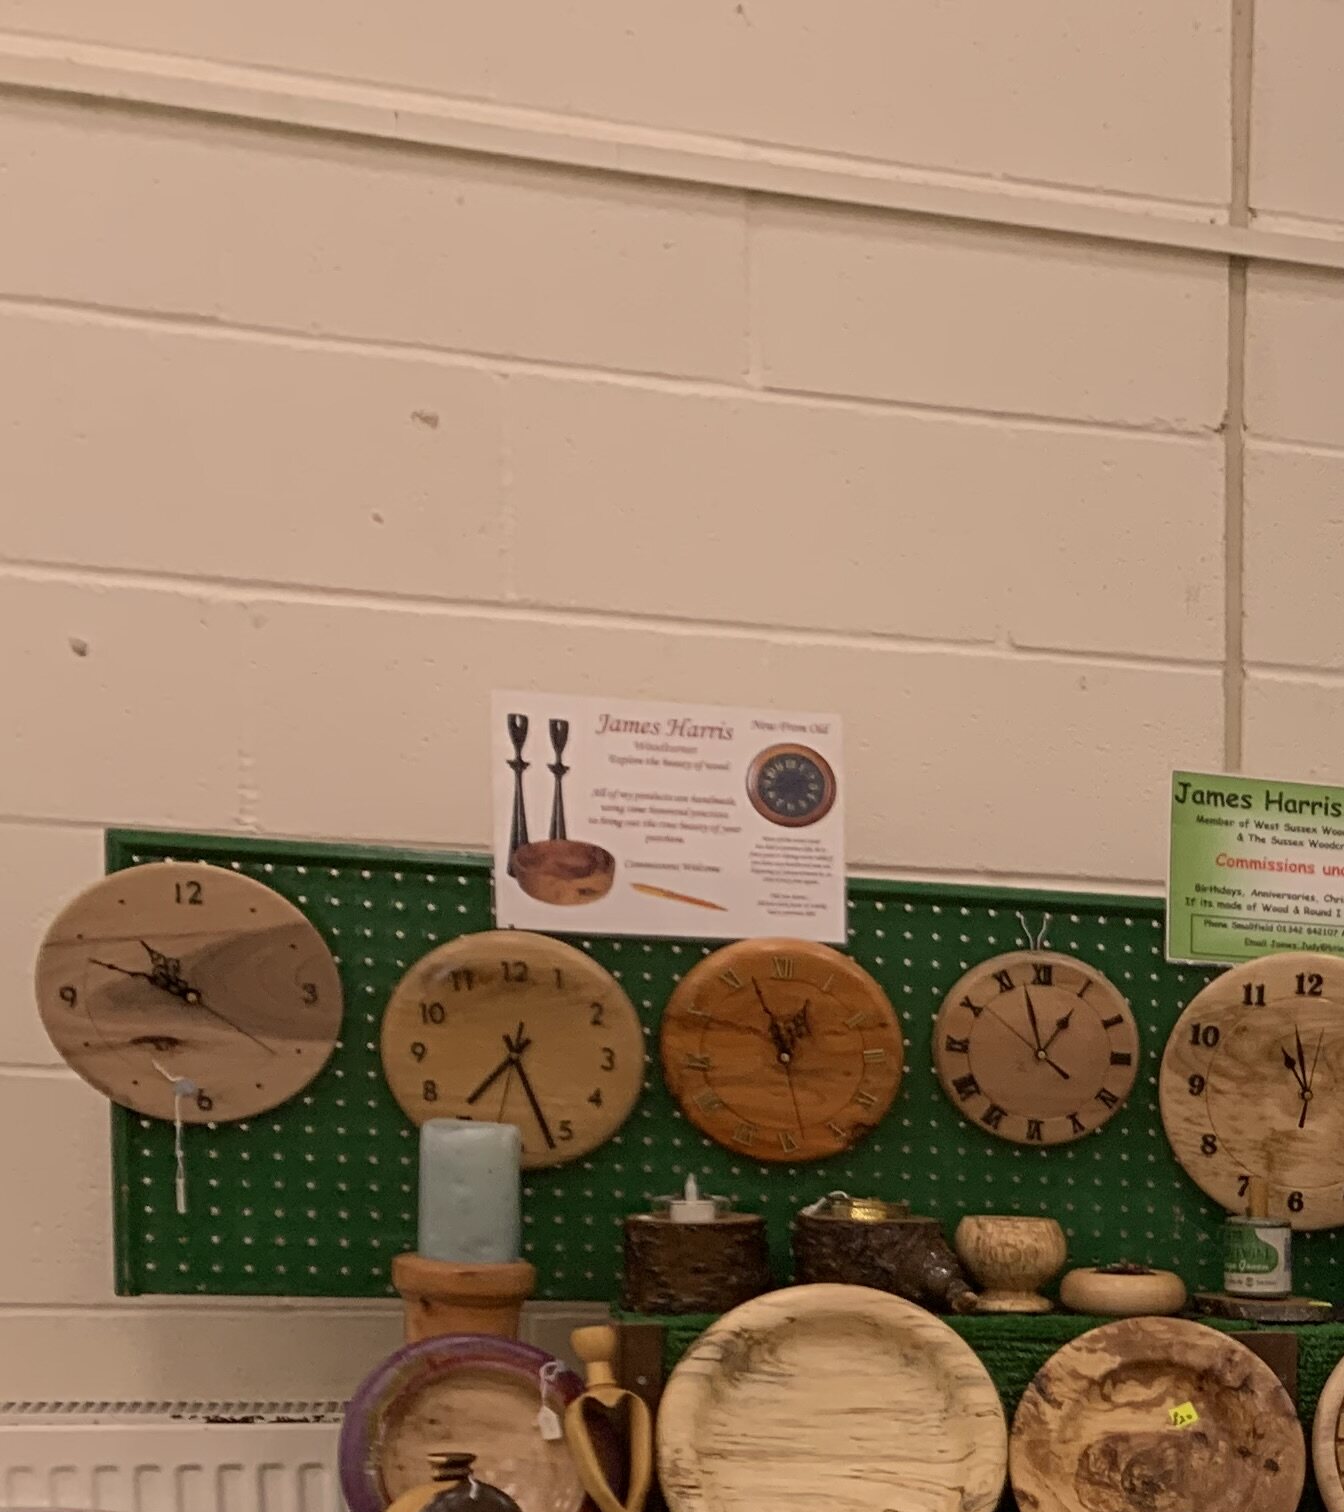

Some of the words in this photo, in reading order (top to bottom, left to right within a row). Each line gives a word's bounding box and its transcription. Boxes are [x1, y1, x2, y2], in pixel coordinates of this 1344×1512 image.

[595, 713, 661, 735] James
[665, 718, 734, 740] Harris
[1175, 782, 1253, 809] James
[1265, 790, 1342, 817] Harris
[1196, 815, 1235, 827] Member
[1239, 819, 1249, 828] of
[1254, 820, 1279, 831] West
[1284, 823, 1317, 834] Sussex
[1237, 833, 1244, 842] &
[1248, 833, 1266, 844] The
[1271, 836, 1304, 847] Sussex
[1215, 852, 1315, 874] Commissions
[174, 880, 203, 905] 12
[1185, 897, 1196, 907] If
[1217, 900, 1242, 910] made
[1246, 903, 1257, 911] of
[1262, 903, 1289, 914] Wood
[1293, 905, 1299, 915] &
[1303, 906, 1332, 917] Round
[451, 969, 474, 992] 11
[501, 961, 528, 983] 12
[554, 968, 564, 989] 1
[1032, 964, 1052, 985] XII
[301, 982, 318, 1007] 3
[1243, 983, 1266, 1006] 11
[1295, 973, 1323, 996] 12
[59, 985, 77, 1008] 9
[960, 996, 984, 1018] X
[419, 1002, 445, 1024] 10
[589, 1002, 605, 1027] 2
[1190, 1023, 1220, 1047] 10
[410, 1042, 426, 1063] 9
[601, 1048, 615, 1071] 3
[423, 1080, 438, 1102] 8
[1188, 1074, 1205, 1096] 9
[197, 1088, 213, 1111] 6
[587, 1088, 602, 1109] 4
[558, 1120, 572, 1140] 5
[1200, 1134, 1217, 1155] 8
[1237, 1176, 1250, 1197] 7
[1287, 1191, 1304, 1212] 6
